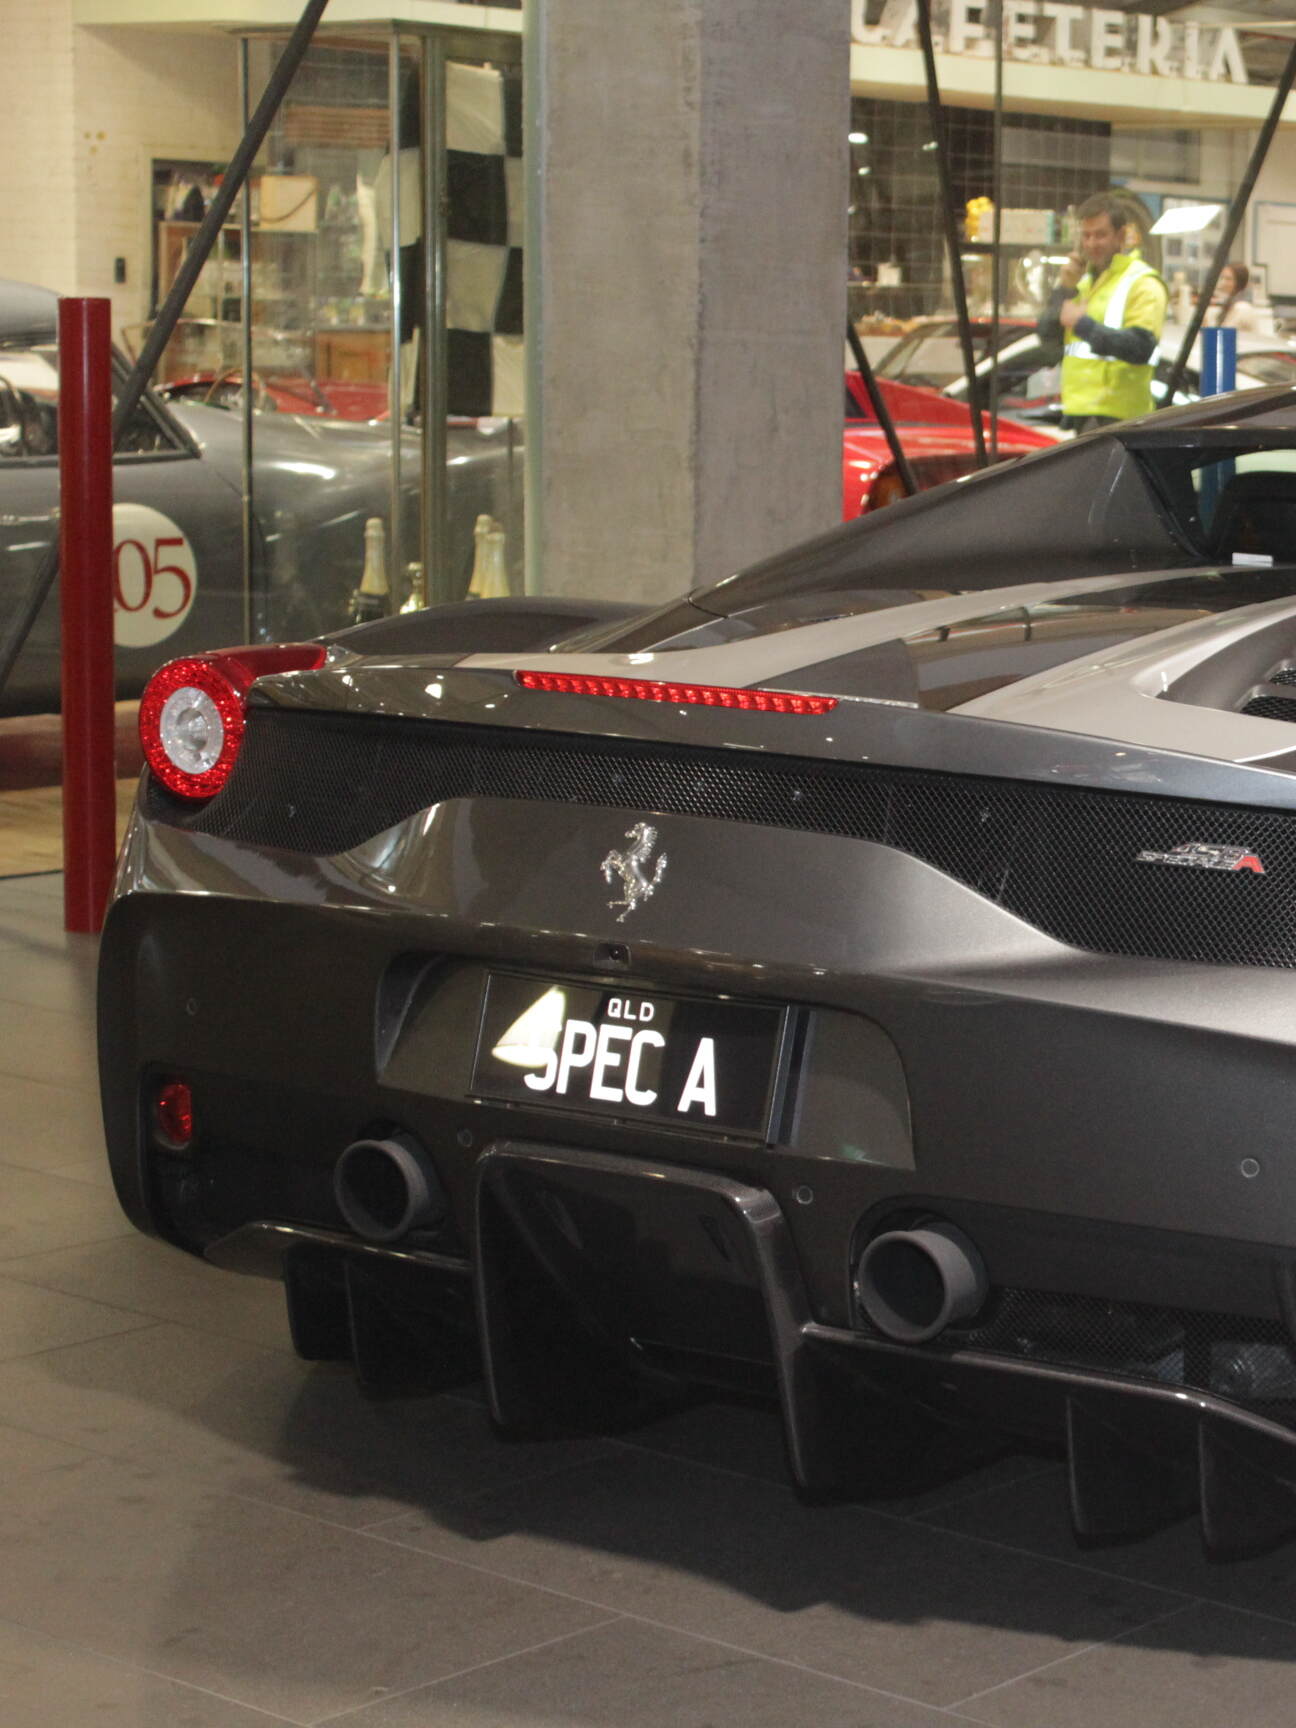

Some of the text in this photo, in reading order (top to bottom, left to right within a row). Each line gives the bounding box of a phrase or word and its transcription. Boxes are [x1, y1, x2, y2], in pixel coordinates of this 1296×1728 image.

[113, 538, 192, 619] 05
[607, 998, 655, 1021] QLD
[677, 1037, 717, 1117] A
